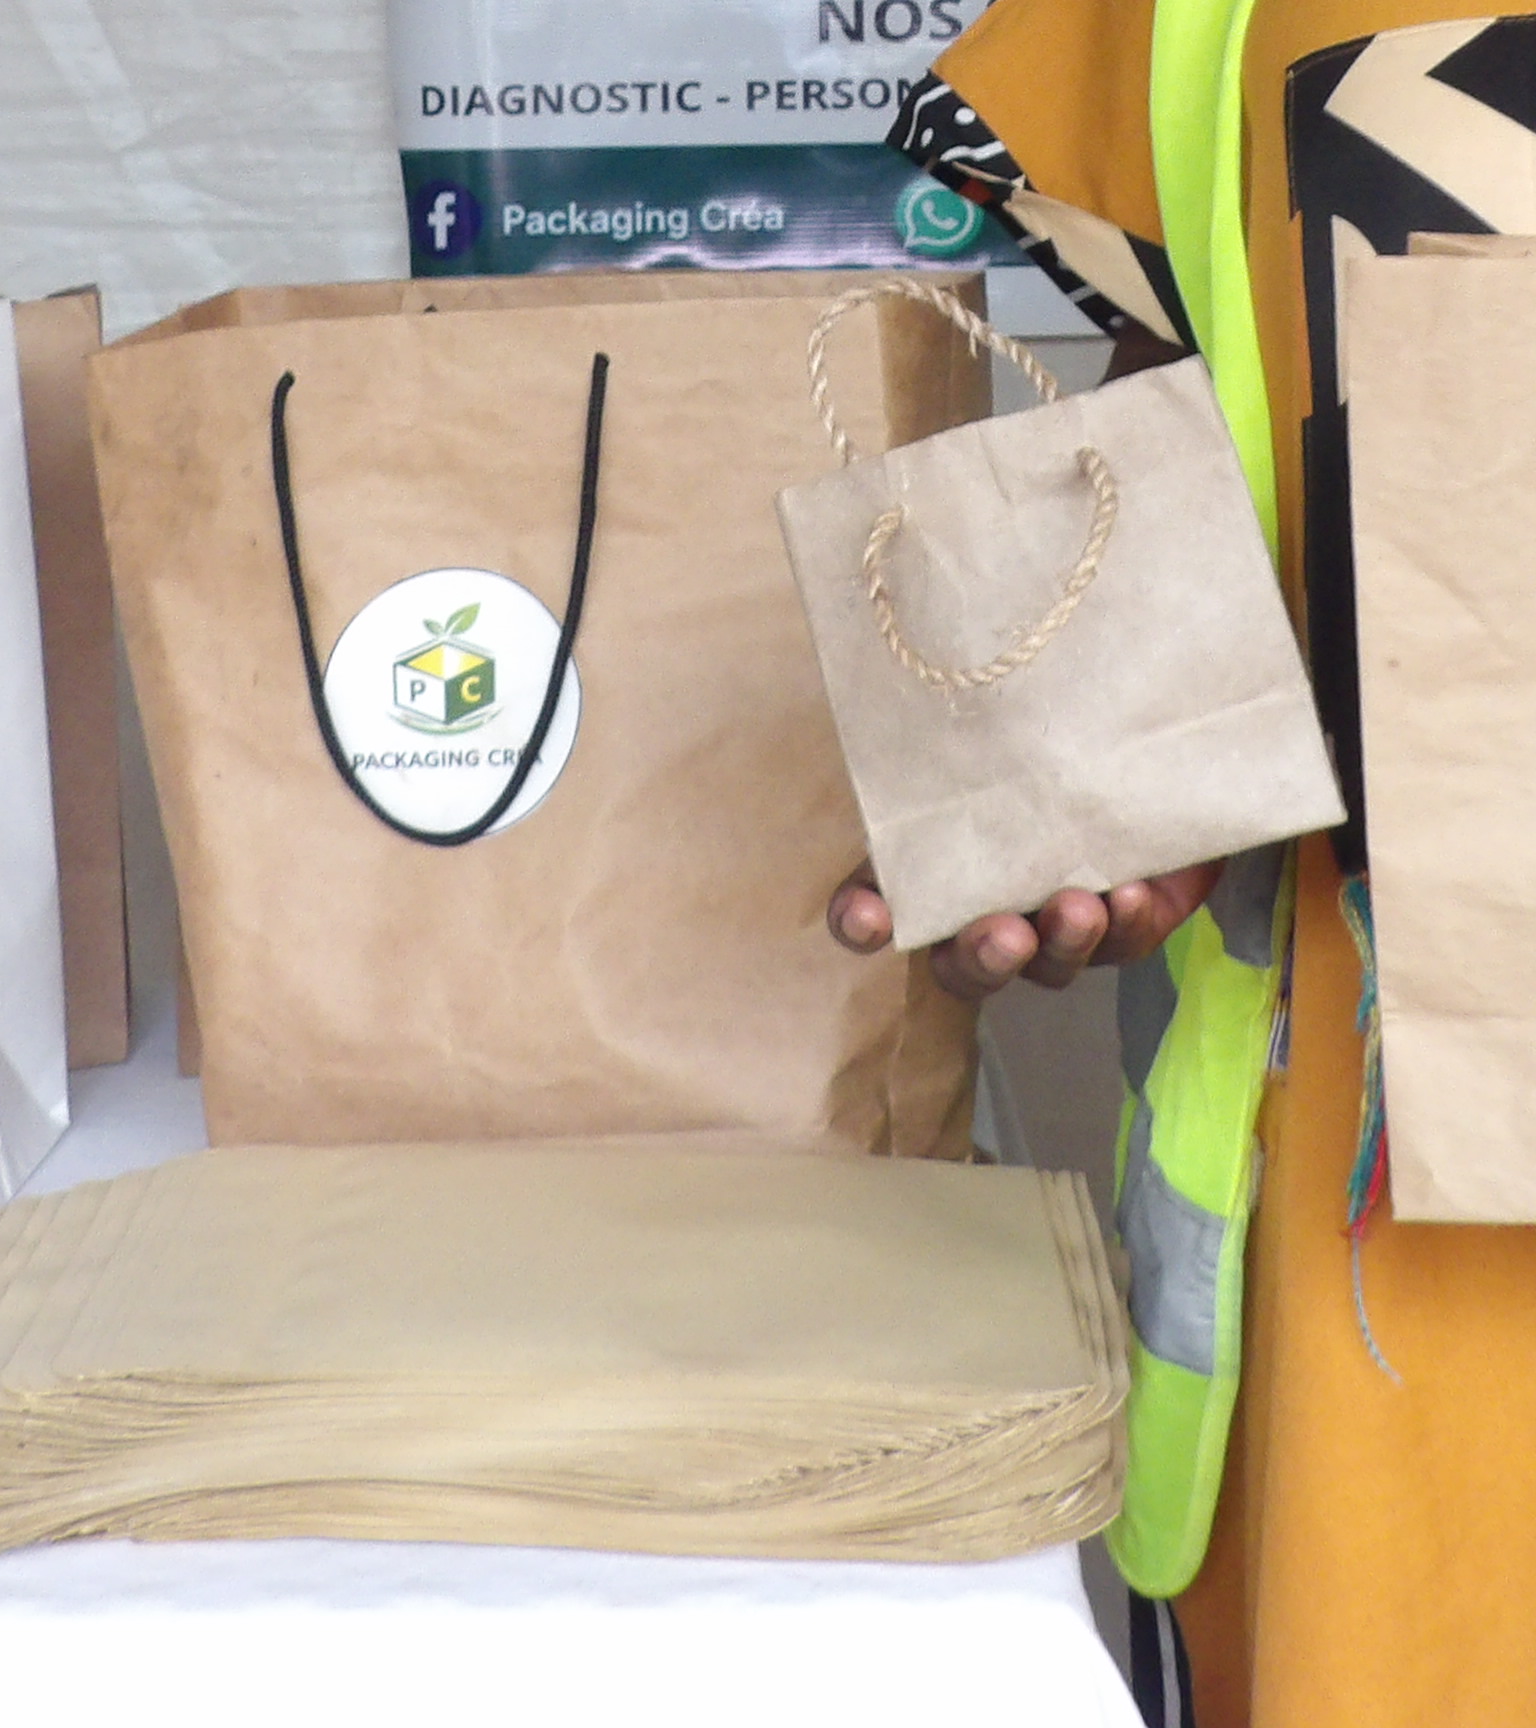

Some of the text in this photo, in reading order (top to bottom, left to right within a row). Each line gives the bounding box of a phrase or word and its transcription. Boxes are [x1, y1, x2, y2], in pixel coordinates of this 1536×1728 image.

[420, 80, 702, 117] DIAGNOSTIC
[501, 201, 691, 241] Packaging
[700, 198, 786, 234] Créa
[409, 675, 482, 702] P C
[352, 749, 480, 771] PACKAGING
